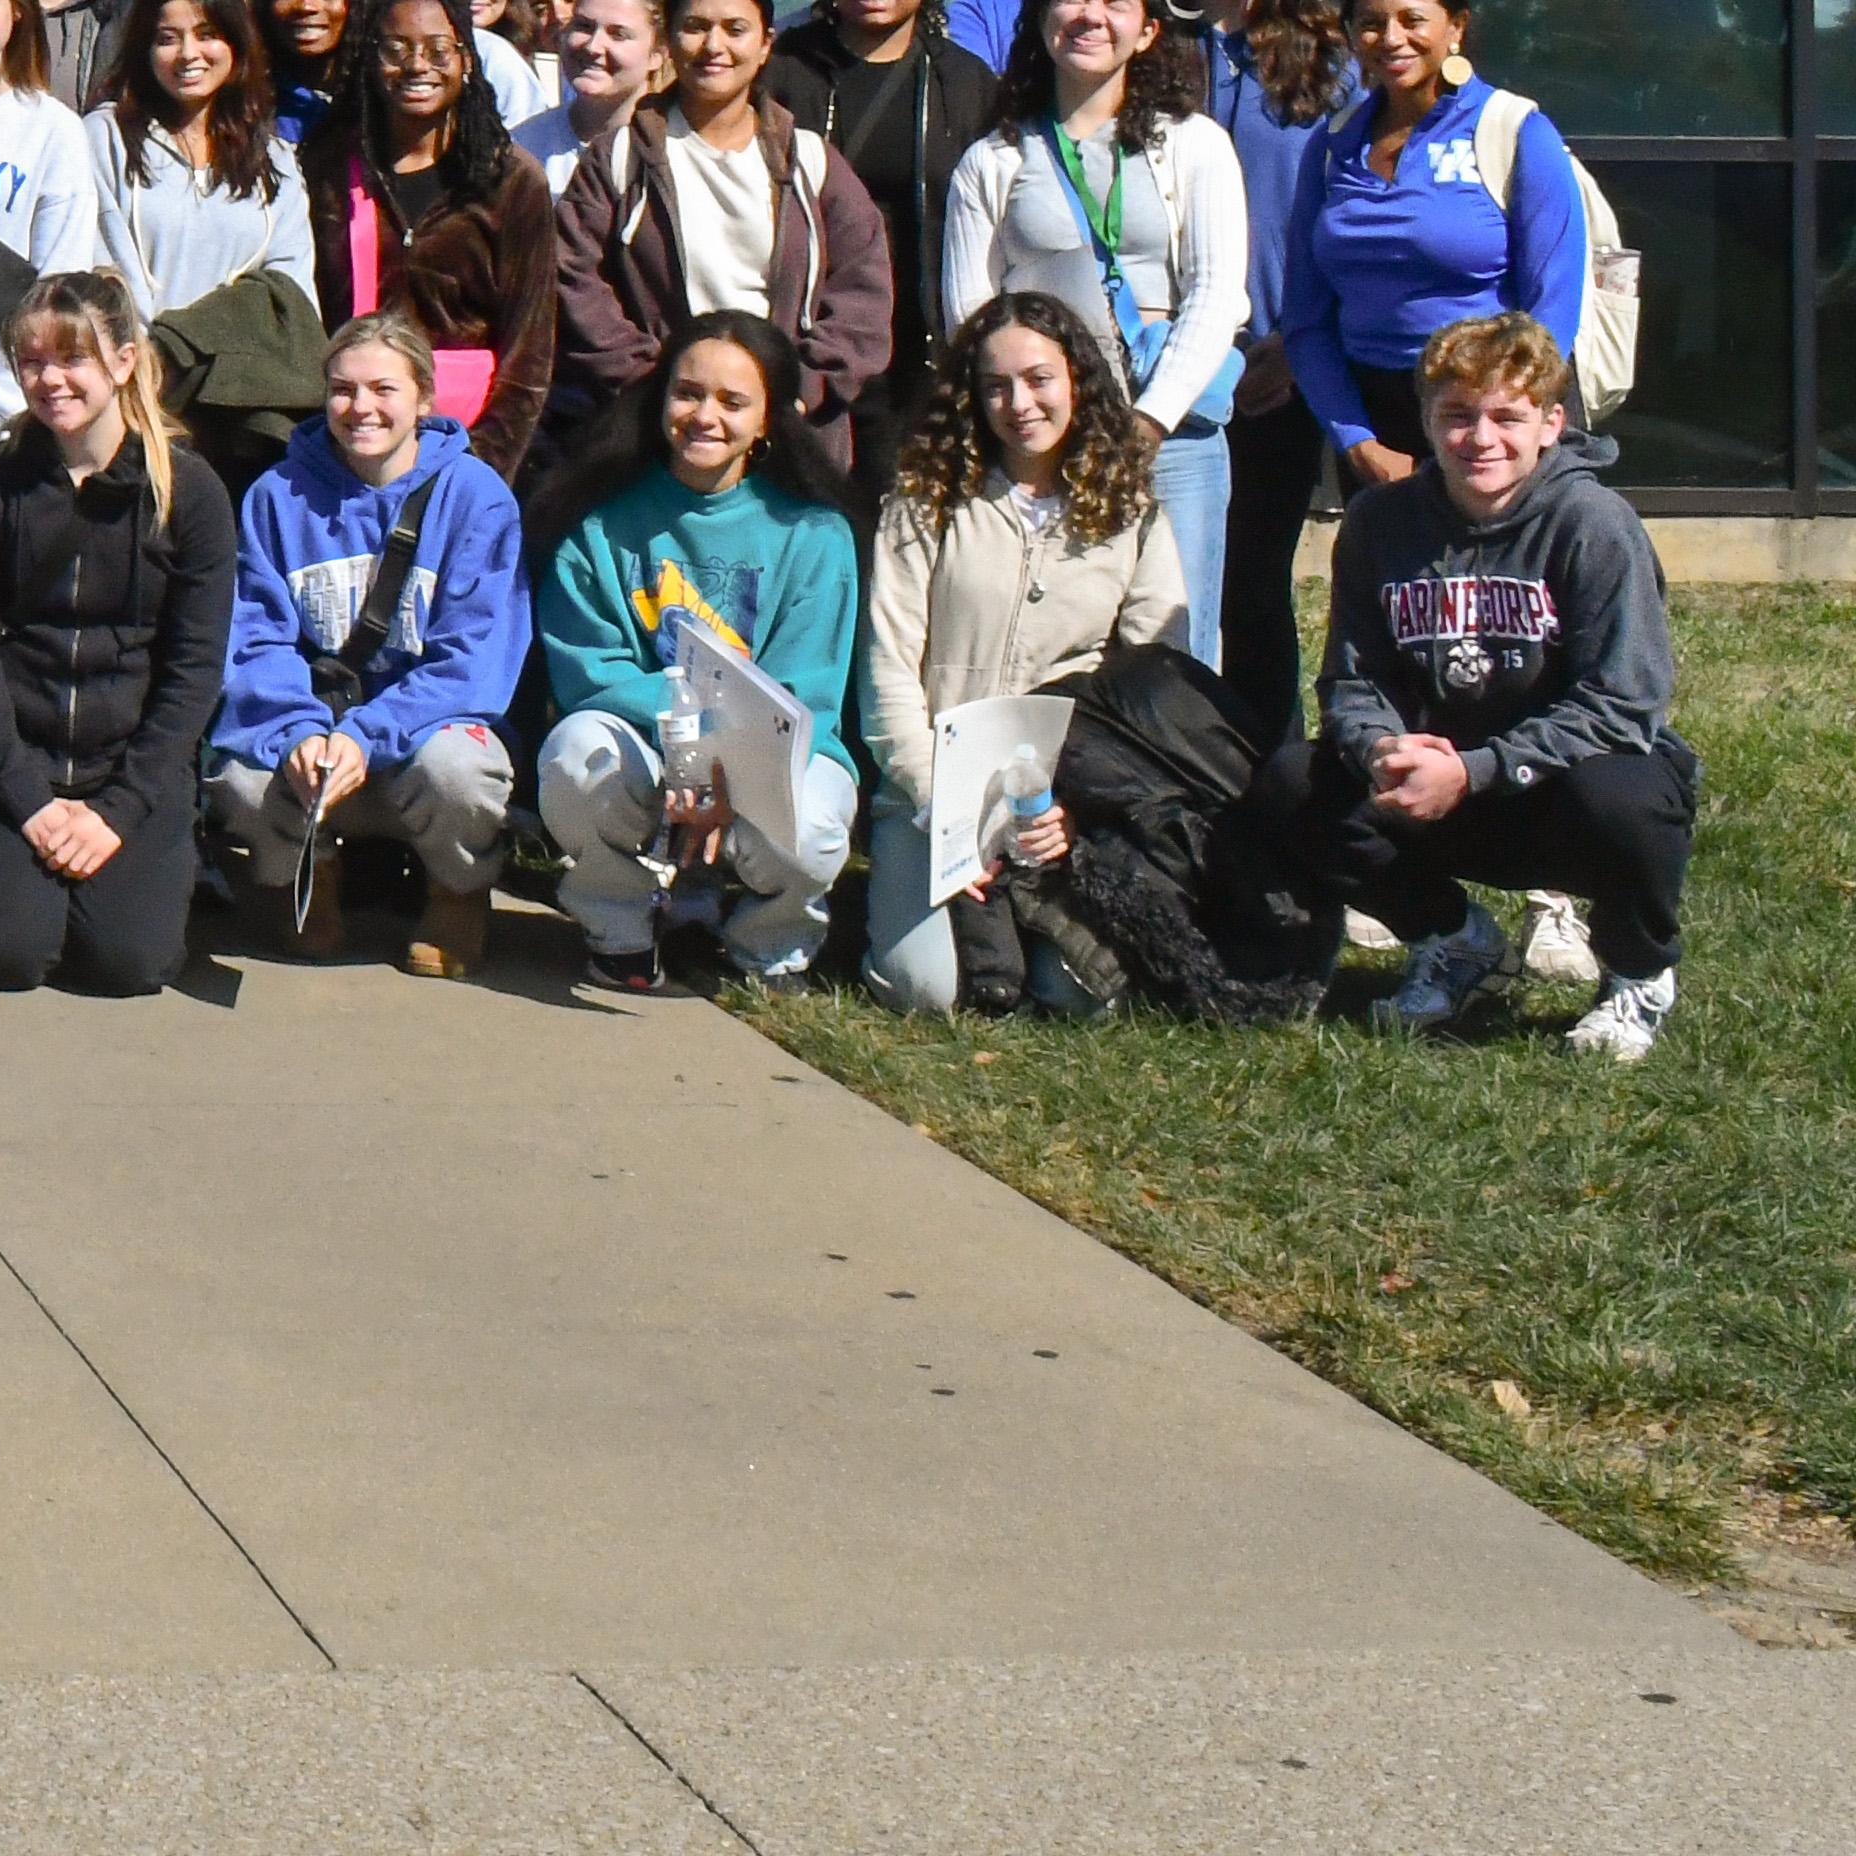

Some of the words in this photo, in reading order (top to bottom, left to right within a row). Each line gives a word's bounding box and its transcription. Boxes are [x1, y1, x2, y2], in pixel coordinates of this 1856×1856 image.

[1427, 138, 1482, 184] UK
[1478, 574, 1563, 646] CORPS
[1501, 649, 1525, 669] 75
